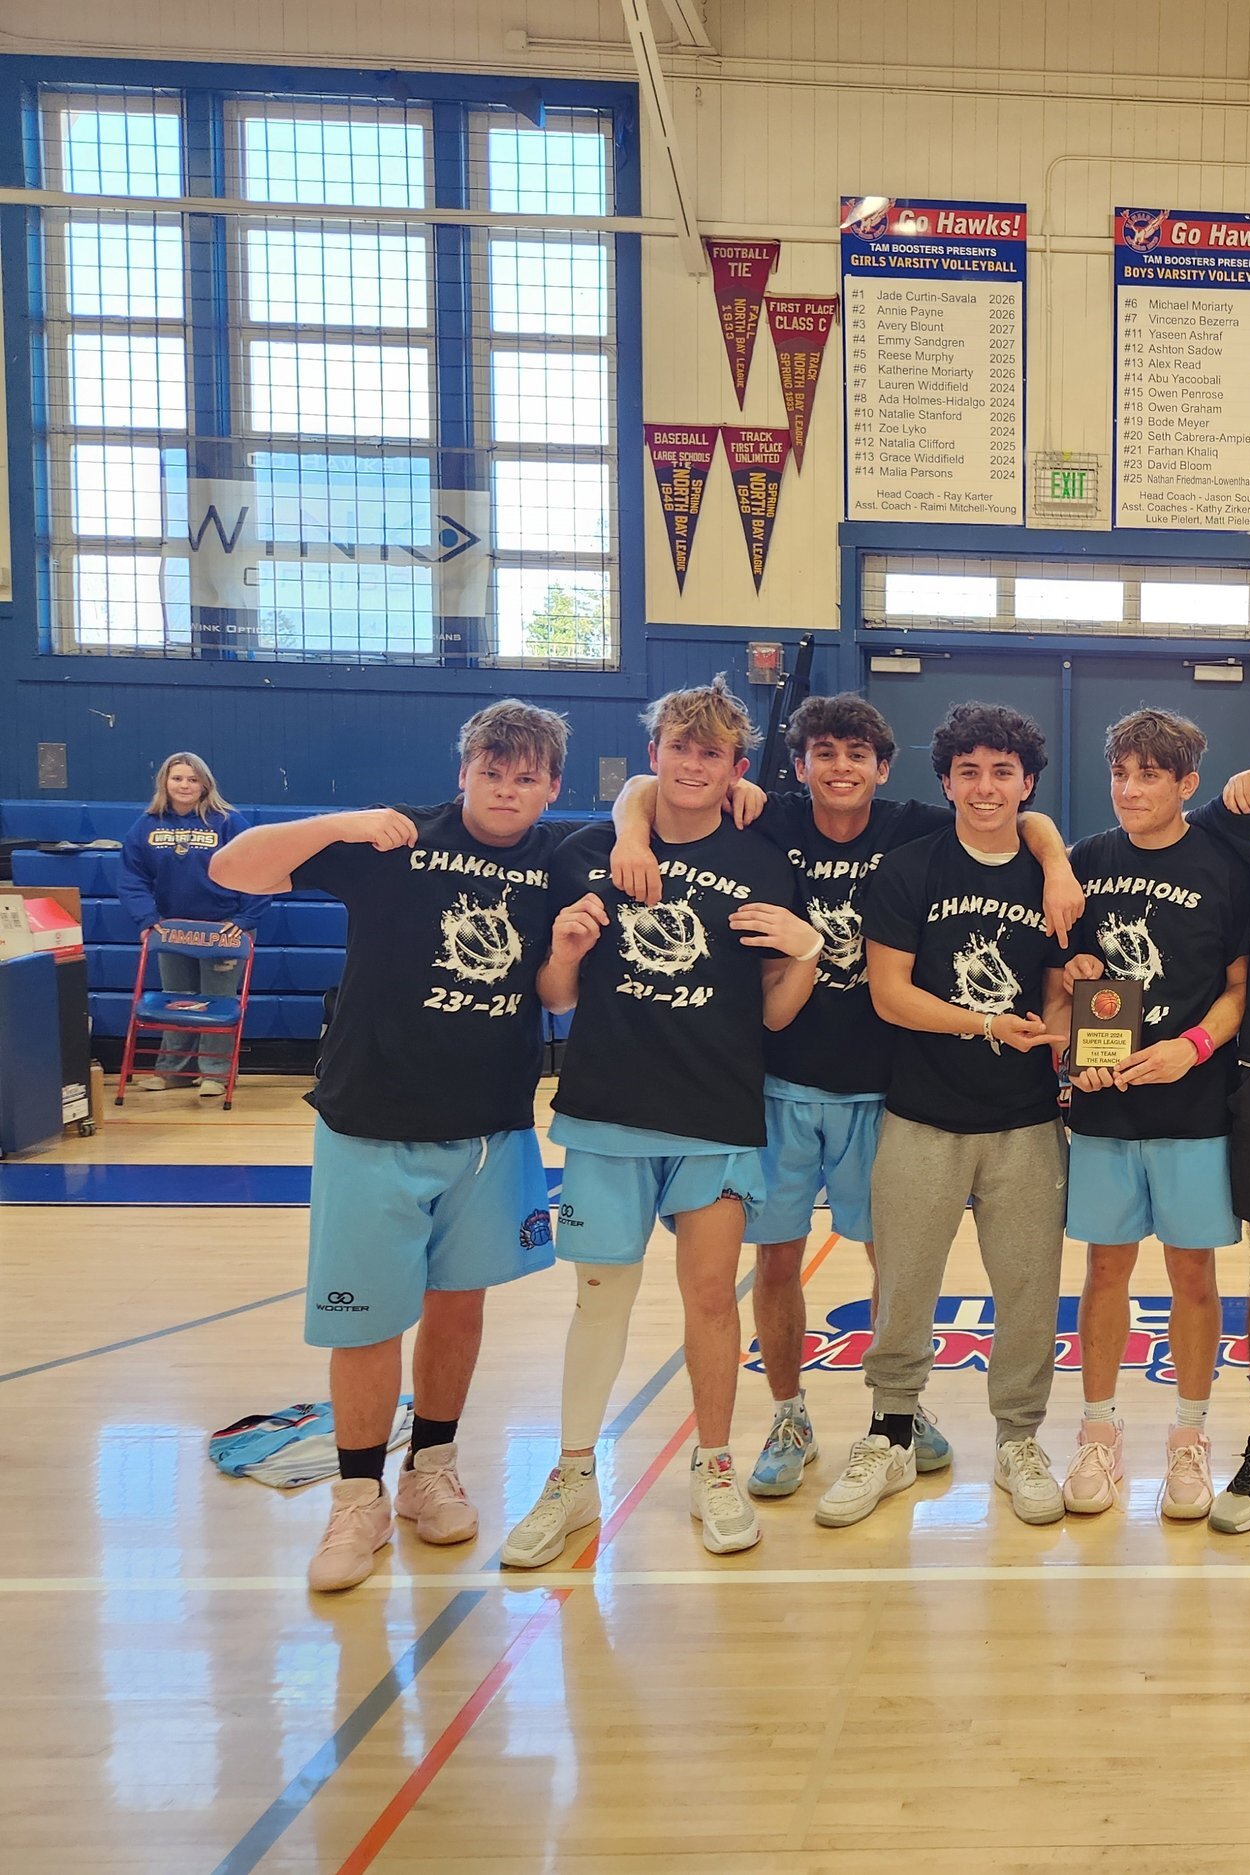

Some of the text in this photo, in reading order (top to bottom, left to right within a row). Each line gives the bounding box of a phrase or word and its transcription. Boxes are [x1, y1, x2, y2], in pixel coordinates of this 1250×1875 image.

[900, 210, 1021, 236] Go Hawks!
[1171, 222, 1200, 245] Go
[713, 248, 769, 260] FOOTBALL
[870, 243, 997, 257] TAM BOOSTERS PRESENTS
[851, 254, 1017, 272] GIRLS VARSITY VOLLEYBALL
[1143, 255, 1162, 264] TAM
[1165, 256, 1215, 266] BOOSTERS
[728, 262, 752, 277] TIE
[1124, 266, 1154, 278] BOYS
[1157, 268, 1205, 281] VARSITY
[852, 290, 1015, 304] #1 Jade Curtin-Savala 2026
[770, 302, 834, 315] FIRST PLACE
[852, 305, 1015, 319] #2 Annie Payne 2026
[1125, 299, 1137, 308] #6
[1149, 300, 1189, 311] Michael
[1192, 301, 1233, 314] Moriarty
[775, 316, 826, 332] CLASS C
[853, 320, 1015, 334] #3 Avery Blount 2027
[1125, 314, 1137, 323] #7
[1149, 314, 1196, 325] Vincenzo
[1200, 316, 1239, 327] Bezerra
[853, 335, 1015, 349] #4 Emmy Sandgren 2027
[1125, 329, 1142, 338] #11
[1150, 329, 1186, 340] Yaseen
[1189, 331, 1223, 341] Ashraf
[853, 350, 1015, 364] #5 Reese Murphy 2025
[1125, 344, 1143, 353] #12
[1149, 345, 1184, 355] Ashton
[1188, 345, 1222, 356] Sadow
[1124, 359, 1143, 367] #13
[1149, 359, 1170, 369] Alex
[1174, 360, 1201, 369] Read
[854, 379, 1015, 393] #7 Lauren Widdifield 2024
[854, 423, 1015, 436] #11 Zoe Lyko 2024
[1124, 417, 1143, 426] #19
[1148, 417, 1174, 427] Bode
[1178, 418, 1209, 429] Meyer
[654, 433, 709, 445] BASEBALL
[653, 451, 710, 463] LARGE SCHOOLS
[736, 453, 779, 463] UNLIMITED
[1124, 460, 1142, 469] #23
[1148, 460, 1176, 470] David
[1180, 461, 1212, 471] Bloom
[855, 466, 1015, 480] #14 Malia Parsons 2024
[1051, 471, 1086, 499] EXIT
[877, 490, 993, 502] Head Coach Ray Karter
[672, 469, 690, 572] NORTH BAY LEAGUE
[1082, 876, 1202, 909] HAMPIONS
